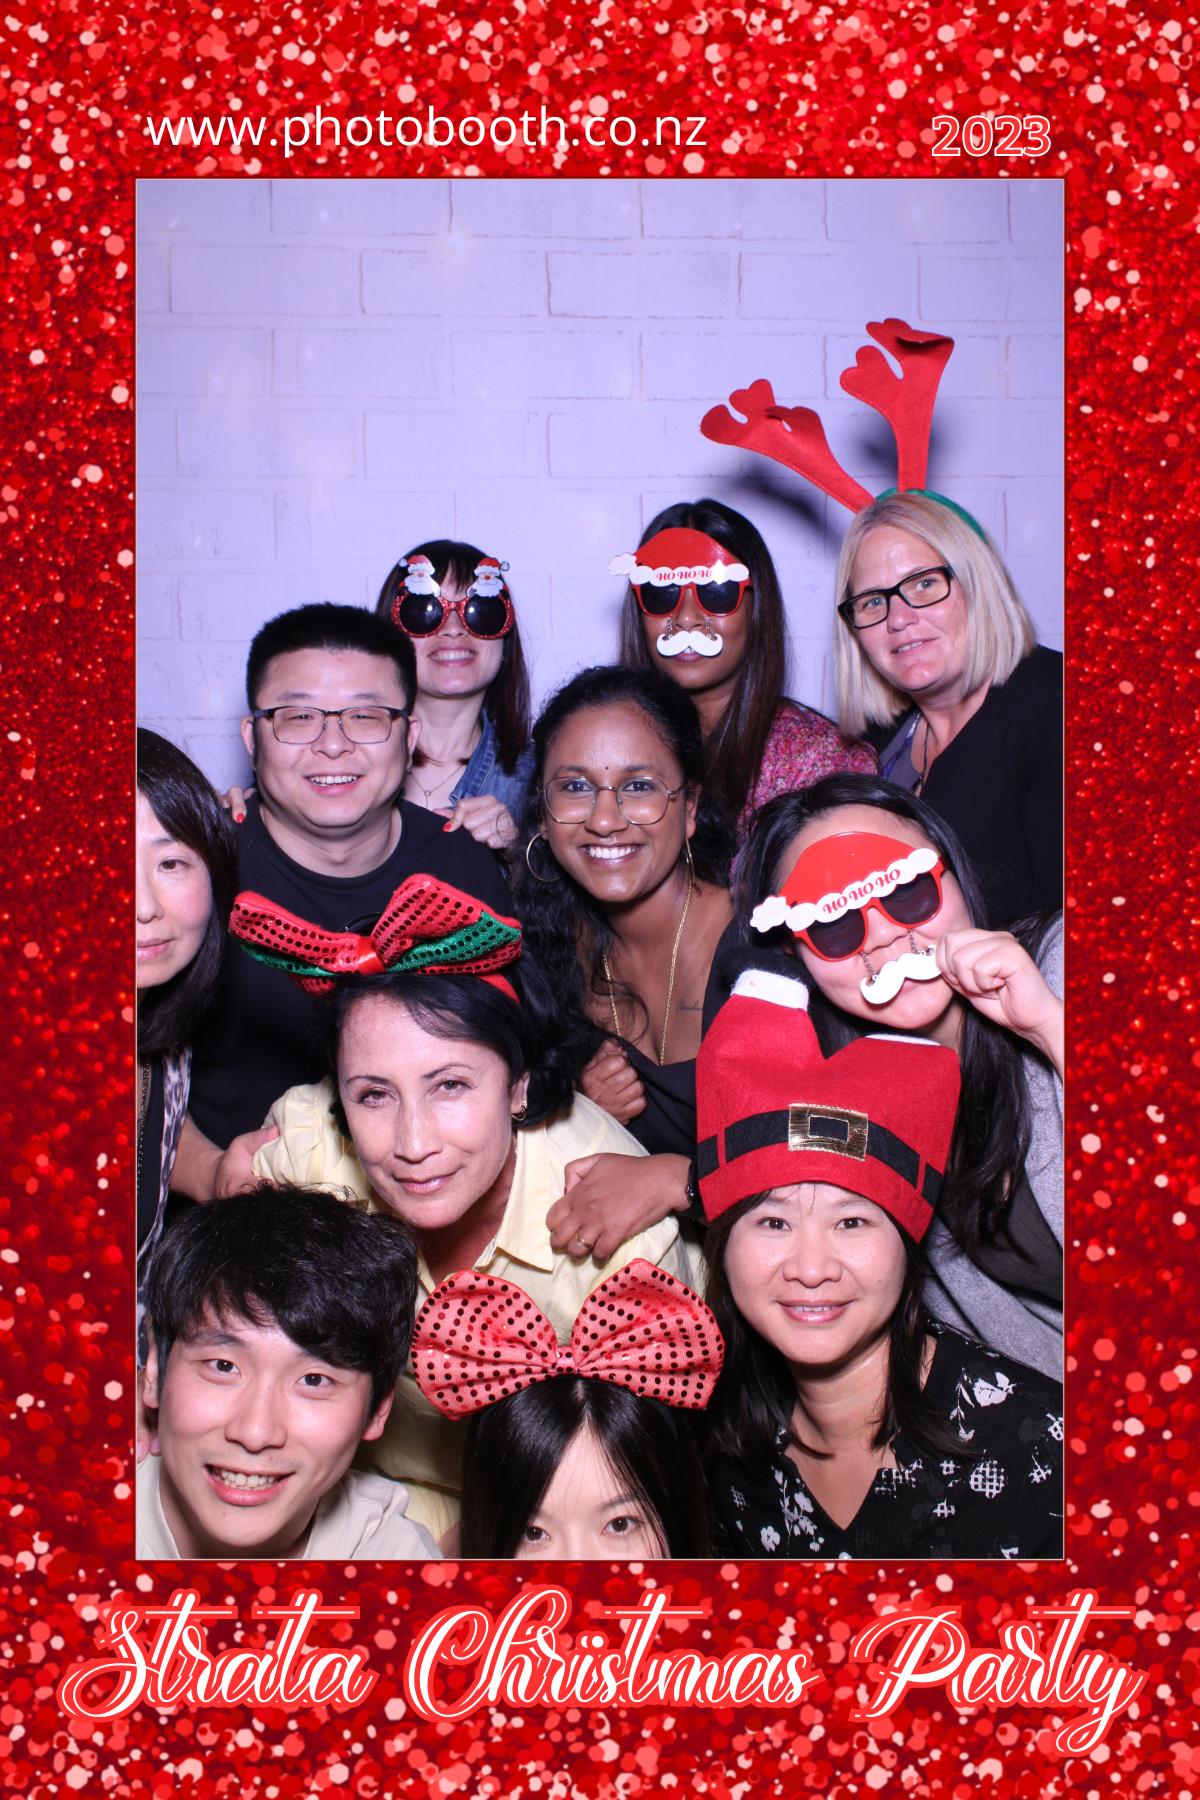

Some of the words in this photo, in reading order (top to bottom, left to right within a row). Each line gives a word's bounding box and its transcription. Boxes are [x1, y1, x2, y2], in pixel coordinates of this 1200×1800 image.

[656, 572, 676, 581] HO
[677, 570, 697, 579] HO
[822, 895, 848, 914] HO
[848, 882, 874, 901] HO
[874, 868, 901, 887] HO
